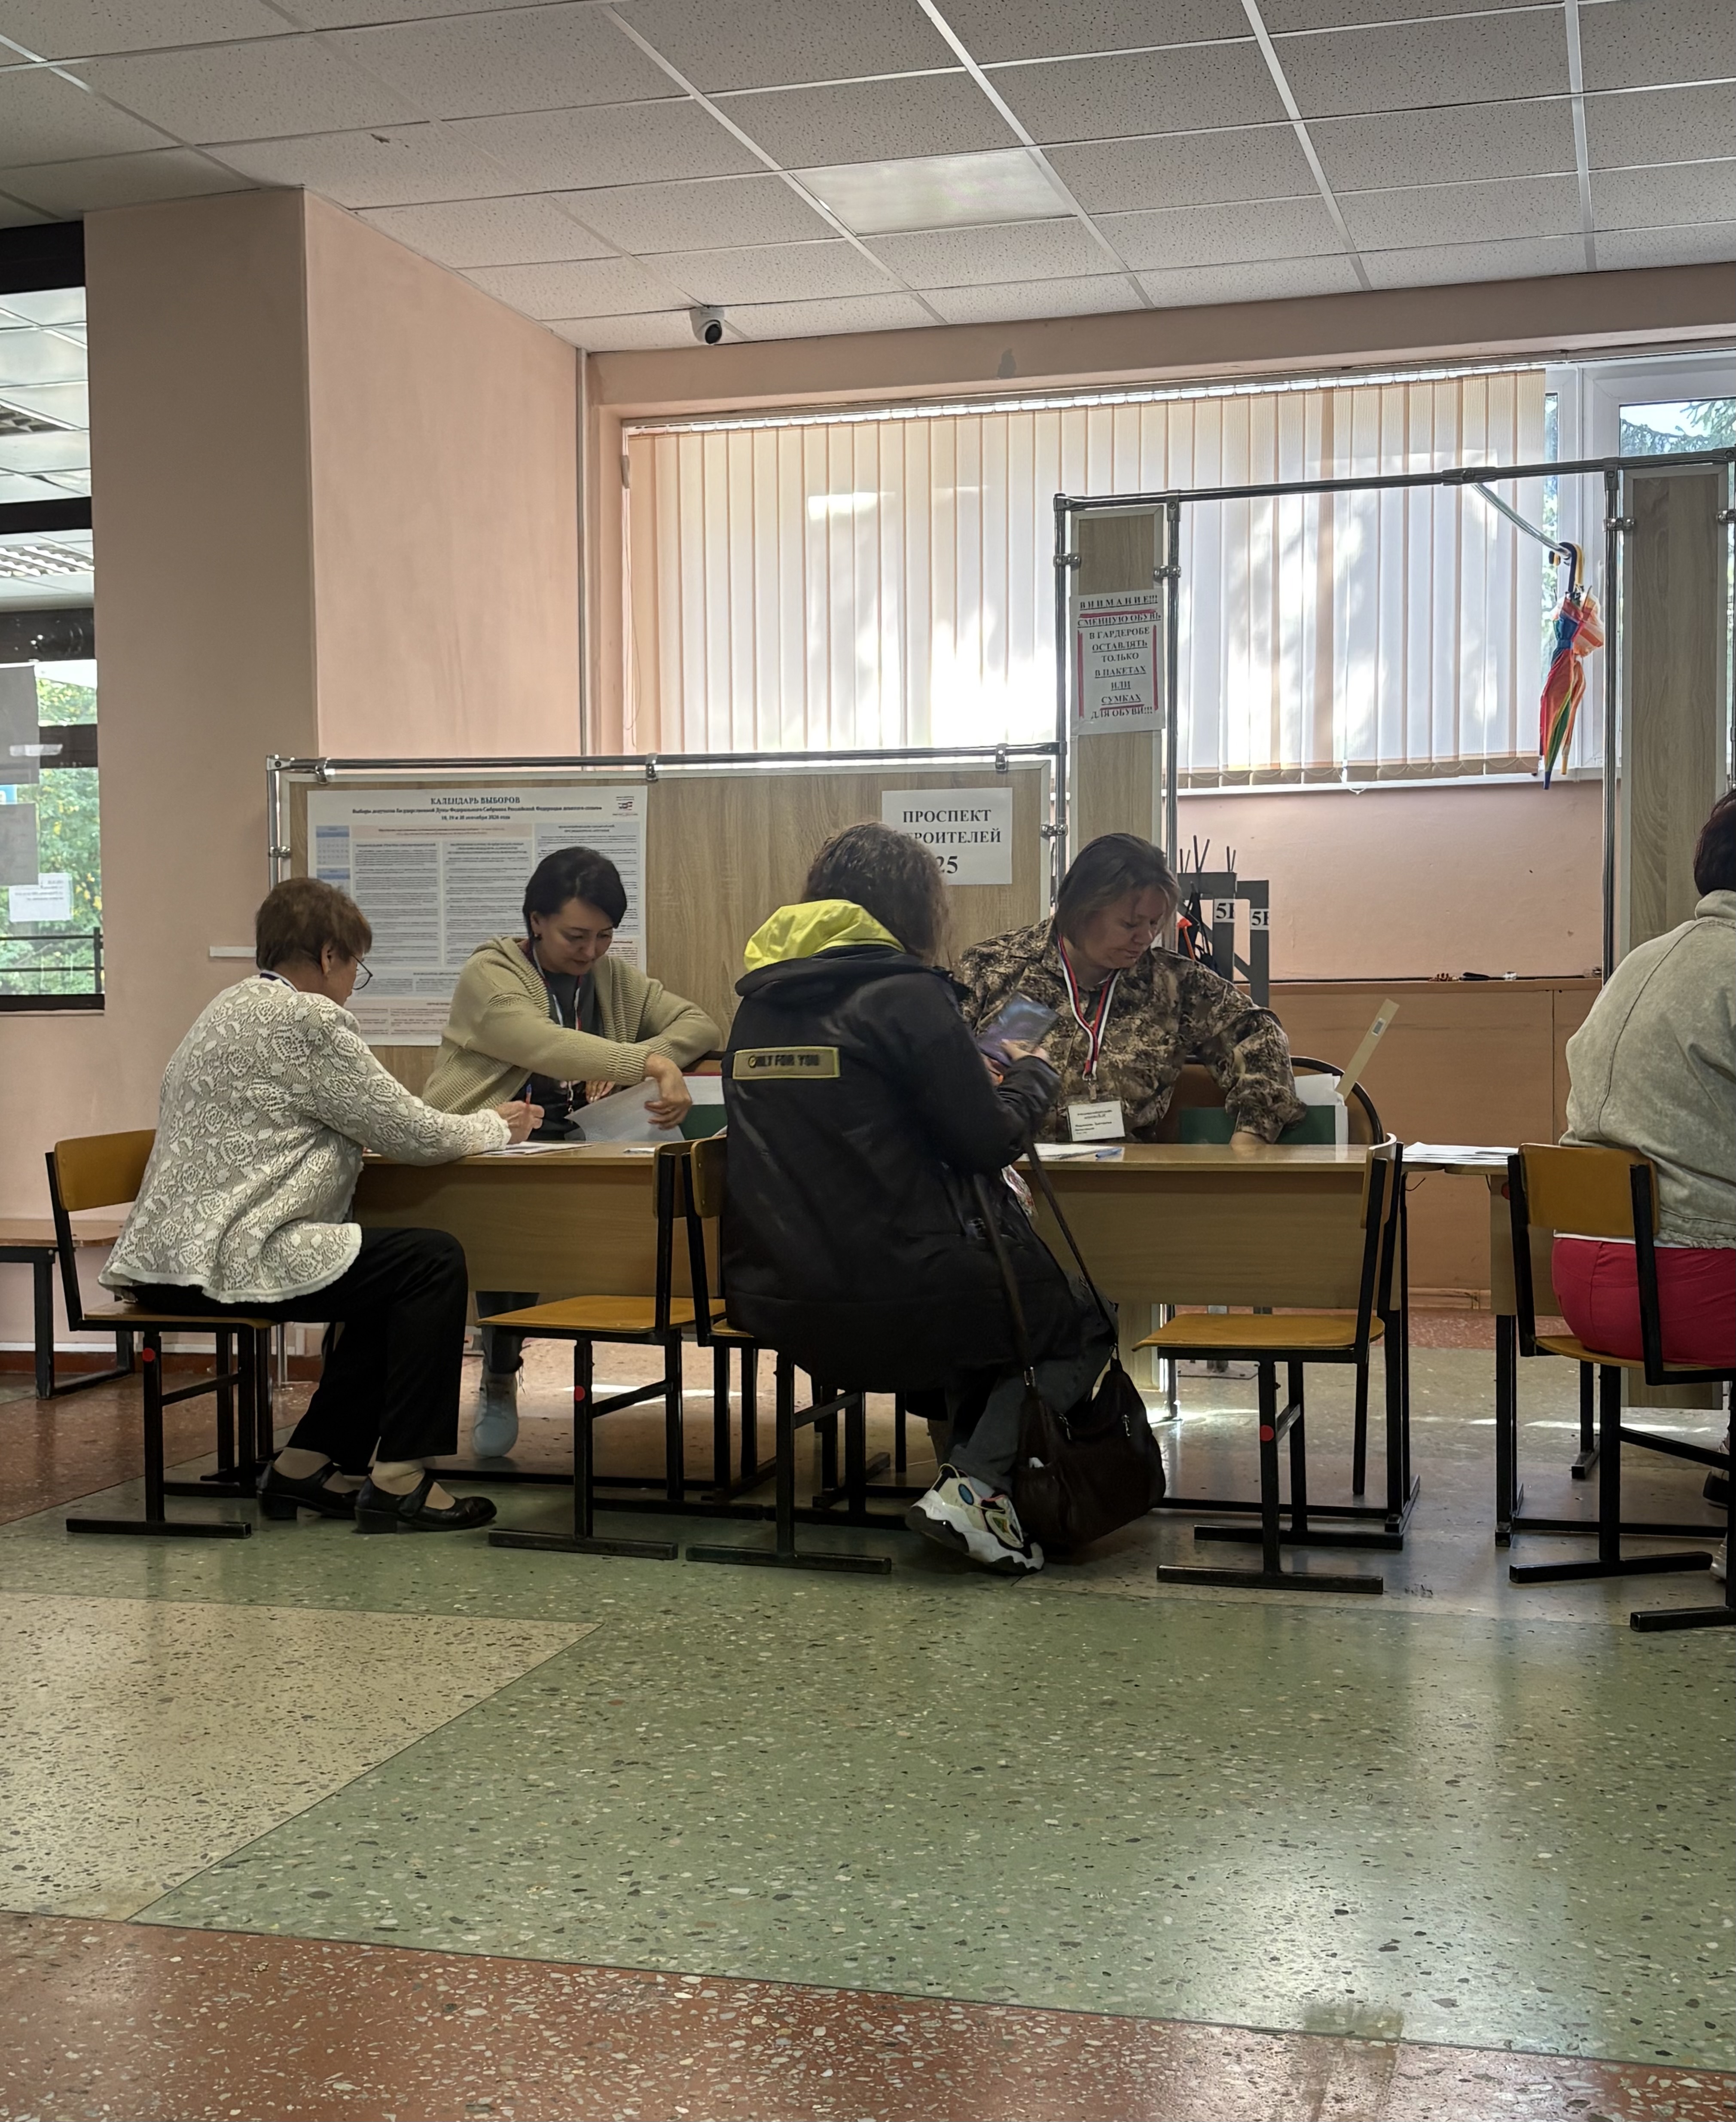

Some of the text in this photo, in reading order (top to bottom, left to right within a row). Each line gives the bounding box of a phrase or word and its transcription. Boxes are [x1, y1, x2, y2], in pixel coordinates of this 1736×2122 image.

[1130, 612, 1161, 623] ОБУВЬ
[1097, 627, 1150, 639] ГАРДЕРОБЕ
[1092, 640, 1148, 651] ОСТАВЛЯТЬ
[1101, 652, 1139, 663] ТОЛЬКО
[1102, 666, 1146, 676] ПАКЕТАХ
[1111, 681, 1131, 689] ИЛИ
[1101, 694, 1141, 704] СУМКАХ
[1091, 710, 1110, 720] ДЛЯ
[903, 810, 992, 823] ПРОСПЕКТ
[909, 828, 1001, 844] РОИТЕЛЕЙ
[936, 856, 958, 873] 25
